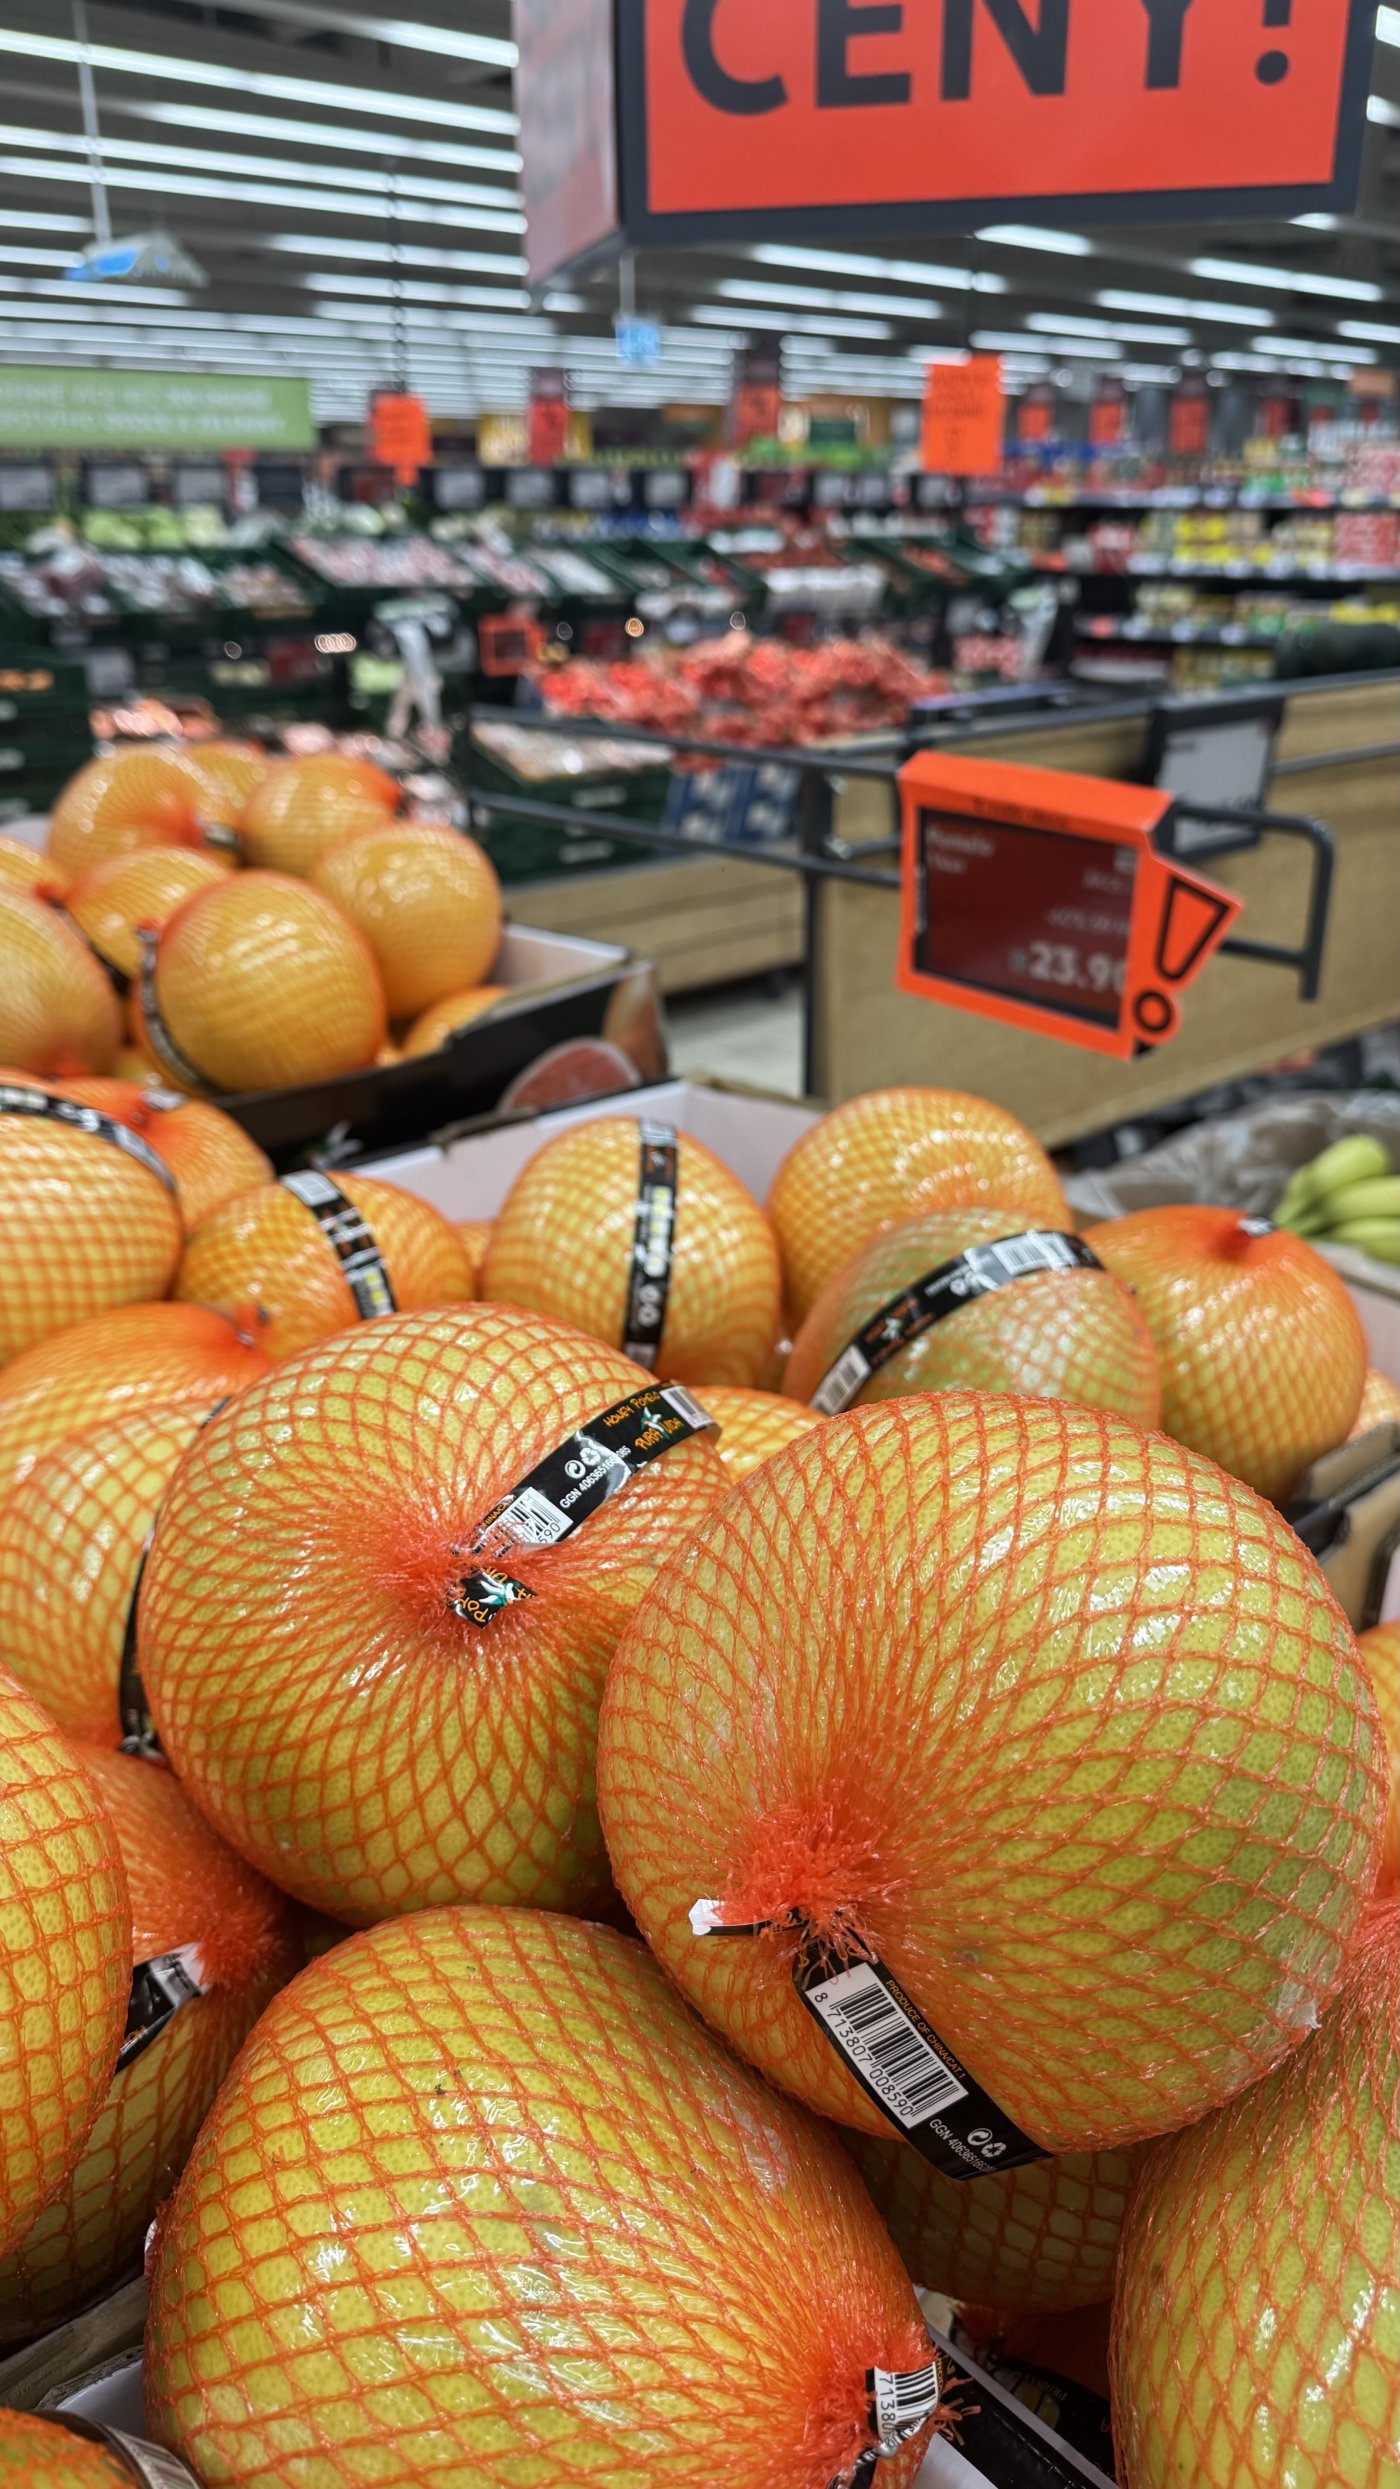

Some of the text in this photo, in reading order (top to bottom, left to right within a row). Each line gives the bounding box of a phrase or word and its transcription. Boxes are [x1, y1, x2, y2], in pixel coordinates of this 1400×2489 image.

[682, 0, 1293, 115] CENY!
[560, 1488, 581, 1509] GGN
[885, 1980, 920, 2022] PRODUCE
[917, 2022, 931, 2034] OF
[814, 1992, 914, 2116] 8 713807 008590
[929, 2118, 953, 2140] GGN
[878, 2374, 896, 2435] 71380
